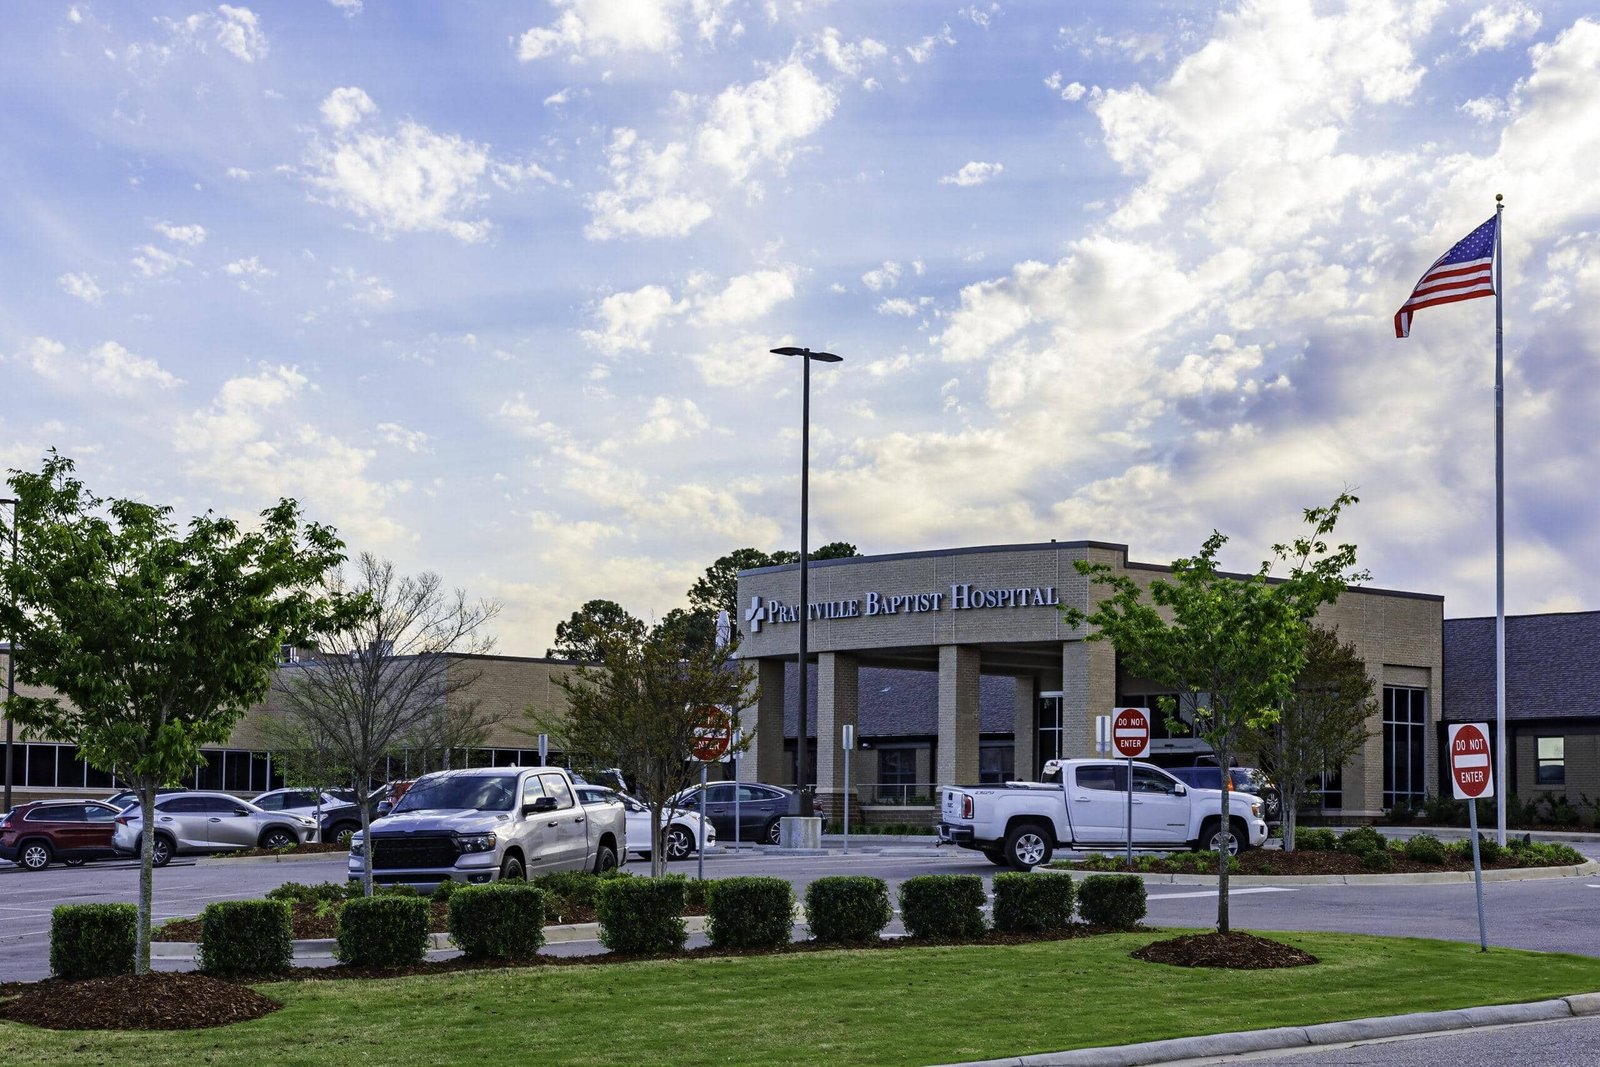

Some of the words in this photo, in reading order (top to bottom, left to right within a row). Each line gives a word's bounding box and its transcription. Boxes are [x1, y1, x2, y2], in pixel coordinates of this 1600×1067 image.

[864, 591, 943, 616] BAPTIST
[950, 583, 1060, 610] HOSPITAL
[1118, 718, 1128, 726] DO
[1130, 718, 1144, 726] NOT
[1120, 739, 1142, 748] ENTER
[1455, 739, 1466, 751] DO
[1469, 738, 1484, 750] NOT
[1460, 770, 1484, 783] ENTER
